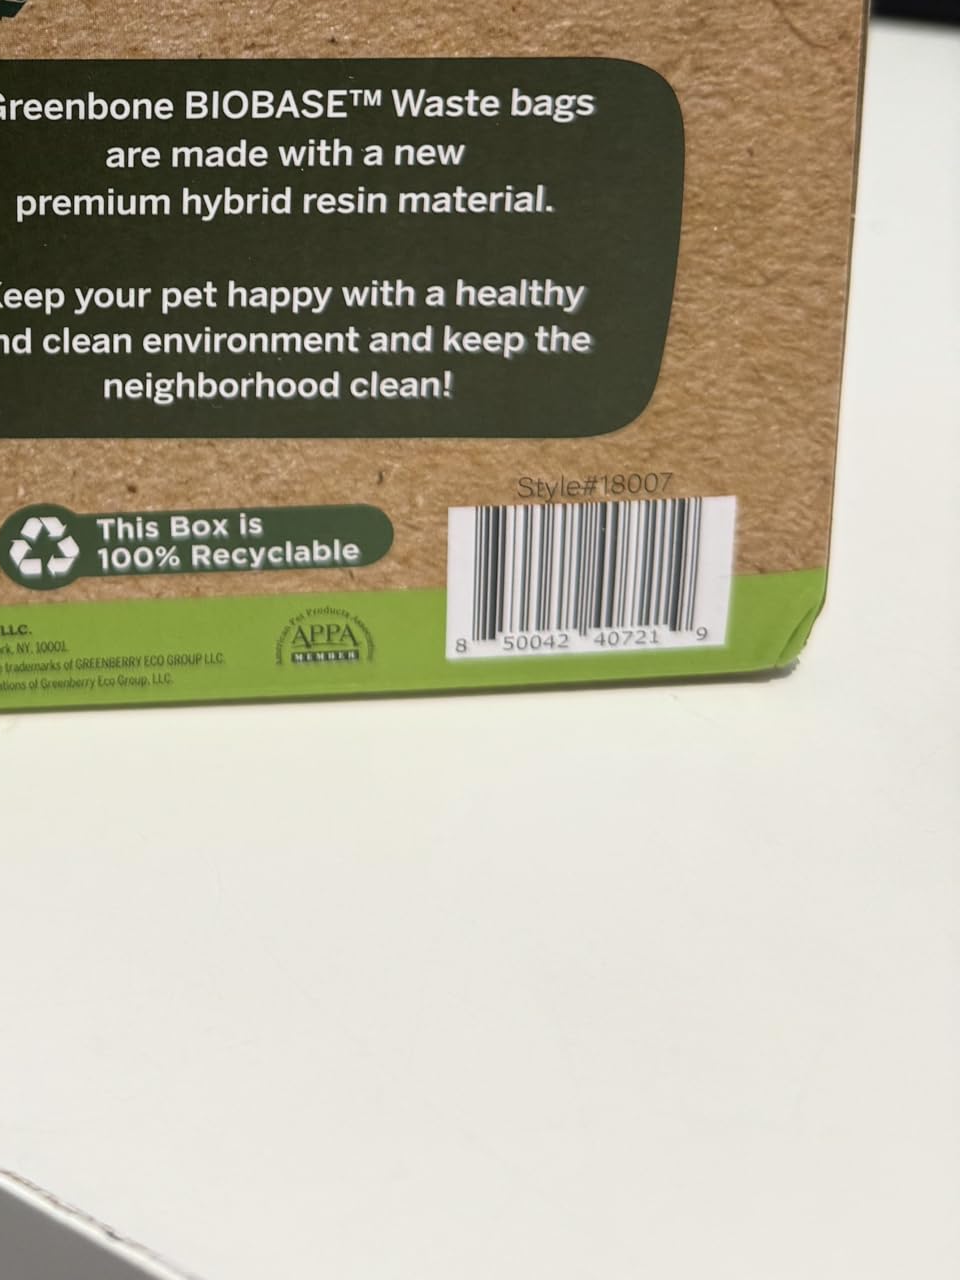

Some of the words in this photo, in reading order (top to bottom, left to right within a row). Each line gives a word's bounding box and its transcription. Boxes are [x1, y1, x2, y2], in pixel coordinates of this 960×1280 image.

[391, 88, 500, 118] Waste
[510, 88, 595, 122] bags
[106, 145, 161, 168] are
[171, 139, 269, 168] made
[278, 138, 352, 167] with
[363, 145, 383, 166] a
[394, 144, 465, 166] new
[16, 188, 170, 223] premium
[182, 187, 291, 221] hybrid
[302, 186, 387, 214] resin
[398, 185, 554, 213] material.
[74, 287, 151, 315] your
[161, 281, 218, 314] pet
[228, 280, 333, 314] happy
[342, 279, 416, 307] with
[425, 285, 445, 307] a
[455, 278, 586, 313] healthy
[42, 326, 132, 354] clean
[142, 325, 359, 354] environment
[369, 325, 433, 353] and
[443, 325, 526, 359] keep
[535, 325, 592, 353] the
[103, 370, 340, 405] neighborhood
[350, 370, 454, 399] clean!
[516, 472, 674, 502] Style#18007
[96, 517, 159, 540] This
[170, 515, 229, 537] Box
[239, 513, 263, 535] is
[97, 545, 181, 570] 100%
[191, 539, 360, 568] Recyclable
[0, 624, 32, 636] LLC.
[292, 624, 360, 649] APPA
[456, 638, 468, 653] 8
[502, 634, 569, 650] 50042
[594, 630, 659, 646] 40721
[696, 626, 708, 640] 9
[4, 660, 61, 673] trademarks
[63, 659, 73, 670] of
[75, 656, 141, 670] GREENBERRY
[144, 655, 164, 667] ECO
[166, 653, 203, 666] GROUP
[28, 678, 38, 689] of
[40, 676, 96, 689] Greenberry
[98, 676, 116, 687] Eco
